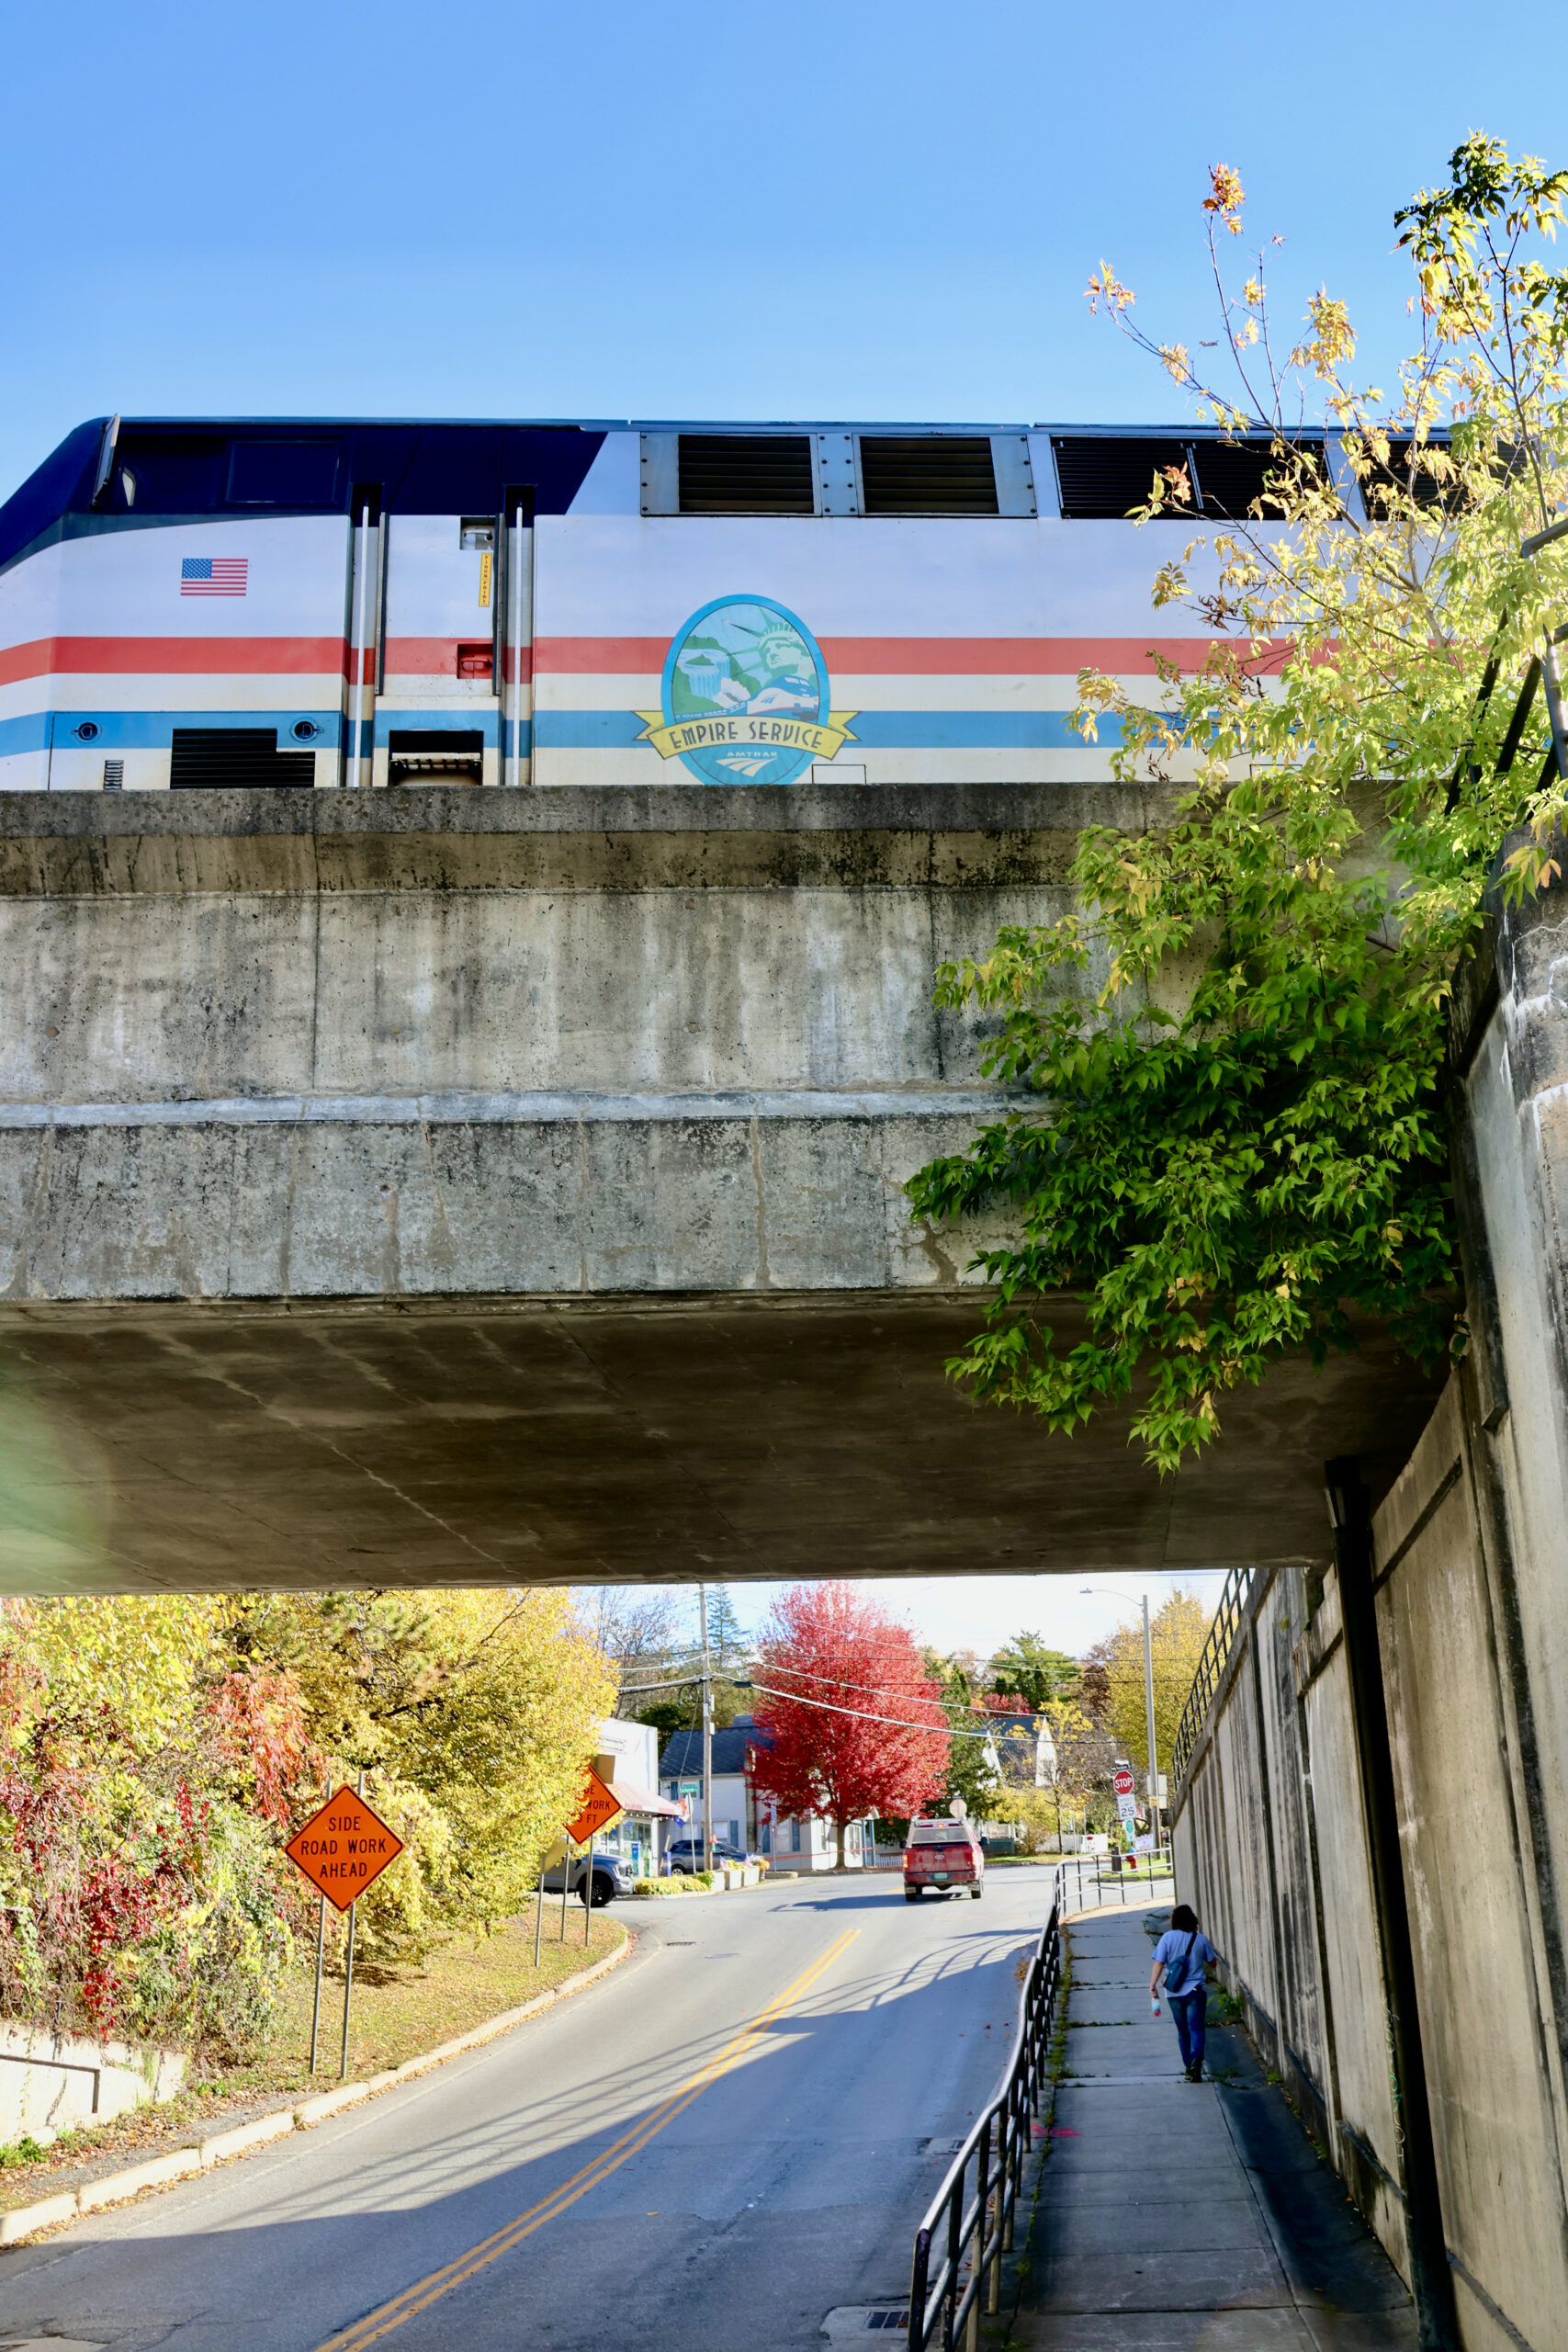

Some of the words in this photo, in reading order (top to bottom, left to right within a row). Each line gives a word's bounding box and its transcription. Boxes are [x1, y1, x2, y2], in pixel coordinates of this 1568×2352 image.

[669, 721, 739, 750] EMPIRE
[749, 720, 822, 749] SERVICE
[1115, 1777, 1132, 1789] STOP
[586, 1814, 597, 1824] FT
[1121, 1806, 1134, 1817] 25
[328, 1816, 361, 1831] SIDE
[300, 1840, 338, 1855] ROAD
[347, 1838, 386, 1854] WORK
[319, 1862, 367, 1878] AHEAD
